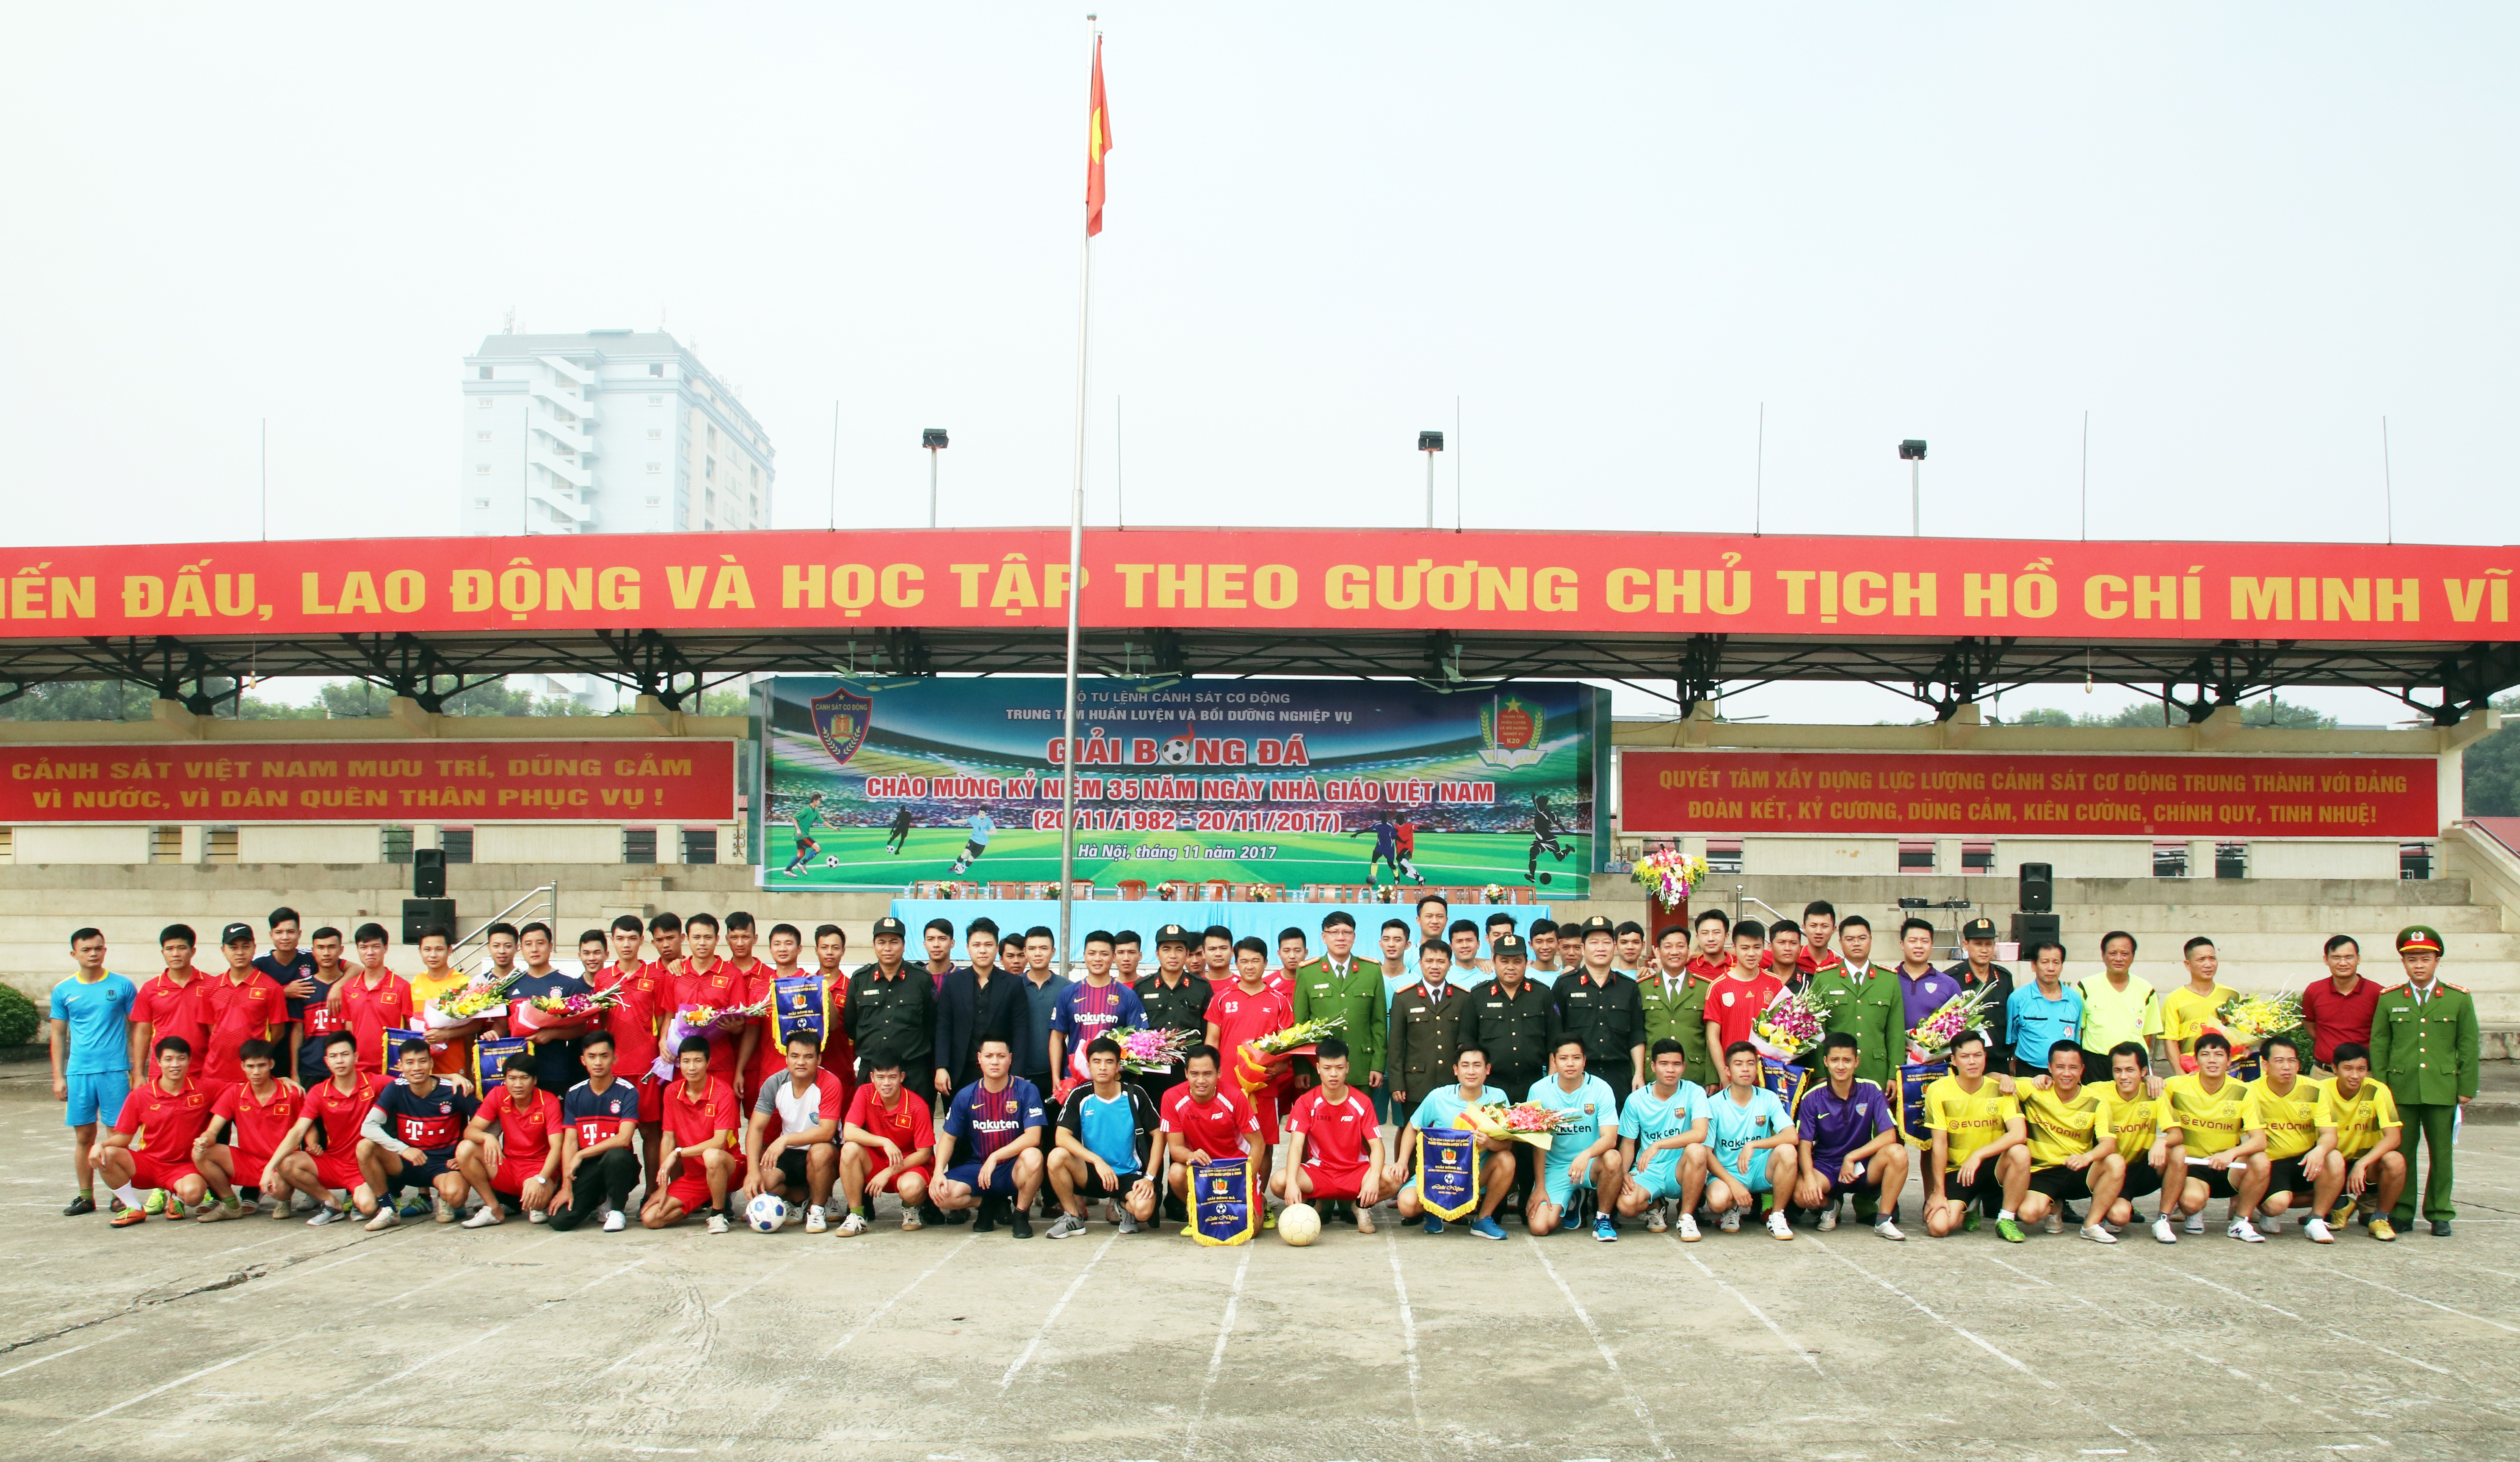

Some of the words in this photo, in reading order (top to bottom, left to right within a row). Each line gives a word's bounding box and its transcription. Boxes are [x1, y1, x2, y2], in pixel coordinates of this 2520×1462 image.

[122, 559, 272, 621] ĐẤU,
[302, 569, 426, 614] LAO
[450, 557, 640, 621] ĐỘNG
[665, 554, 755, 609] VÀ
[782, 563, 924, 617] HỌC
[950, 553, 1089, 616] TẬP
[1115, 564, 1298, 609] THEO
[1325, 559, 1578, 612] GƯƠNG
[1606, 552, 1751, 615] CHỦ
[1777, 571, 1937, 623] TỊCH
[1964, 557, 2057, 618] HỒ
[2084, 565, 2205, 620] CHÍ
[2230, 577, 2419, 621] MINH
[2443, 568, 2513, 622] VĨ
[1091, 692, 1108, 702] TƯ
[1113, 690, 1147, 705] LỆNH
[1152, 690, 1191, 703] CẢNH
[1195, 690, 1222, 703] SÁT
[1226, 692, 1246, 703] CƠ
[1249, 691, 1290, 706] ĐỘNG
[1006, 709, 1051, 720] TRUNG
[1089, 706, 1126, 720] HUẤN
[1131, 708, 1174, 723] LUYỆN
[1179, 708, 1196, 720] VÀ
[1198, 706, 1223, 720] BỒI
[1227, 707, 1275, 721] DƯỠNG
[1279, 709, 1330, 723] NGHIỆP
[1335, 711, 1352, 724] VỤ
[1047, 727, 1122, 764] GIẢI
[1256, 734, 1310, 765] ĐÁ
[12, 758, 98, 779] CẢNH
[111, 759, 171, 778] SÁT
[185, 758, 251, 781] VIỆT
[262, 761, 337, 777] NAM
[348, 759, 422, 777] MƯU
[435, 756, 495, 778] TRÍ,
[508, 754, 601, 776] DŨNG
[614, 753, 691, 776] CẢM
[866, 772, 928, 798] CHÀO
[934, 774, 1002, 799] MỪNG
[1006, 770, 1038, 800] KỶ
[1107, 778, 1139, 800] 35
[1142, 774, 1197, 800] NĂM
[1202, 774, 1266, 801] NGÀY
[1270, 775, 1320, 802] NHÀ
[1324, 775, 1380, 803] GIÁO
[1384, 777, 1435, 807] VIỆT
[1440, 781, 1495, 803] NAM
[1660, 765, 1721, 789] QUYẾT
[1729, 767, 1769, 788] TÂM
[1775, 767, 1813, 789] XÂY
[1819, 770, 1872, 792] DỰNG
[1879, 770, 1915, 793] LỰC
[1921, 771, 1985, 793] LƯỢNG
[1992, 766, 2044, 790] CẢNH
[2051, 769, 2087, 790] SÁT
[2093, 773, 2119, 791] CƠ
[2125, 771, 2177, 794] ĐỘNG
[2184, 775, 2245, 792] TRUNG
[2252, 772, 2314, 792] THÀNH
[2321, 771, 2351, 792] VỚI
[2355, 770, 2407, 793] ĐẢNG
[33, 789, 61, 808] VÌ
[73, 786, 170, 809] NƯỚC,
[180, 788, 209, 807] VÌ
[221, 787, 288, 807] DÂN
[300, 786, 388, 808] QUÊN
[398, 786, 486, 806] THÂN
[498, 789, 589, 810] PHỤC
[600, 789, 644, 810] VỤ
[655, 789, 663, 806] !
[1033, 808, 1177, 832] (20/11/1982
[1180, 818, 1192, 826] -
[1196, 810, 1342, 835] 20/11/2017)
[1688, 797, 1743, 818] ĐOÀN
[1751, 796, 1792, 821] KẾT,
[1799, 796, 1823, 819] KỶ
[1830, 800, 1902, 821] CƯƠNG,
[1908, 798, 1961, 820] DŨNG
[1968, 797, 2017, 822] CẢM,
[2024, 800, 2069, 821] KIÊN
[2075, 798, 2147, 823] CƯỜNG,
[2153, 801, 2213, 822] CHÍNH
[2219, 805, 2262, 824] QUY,
[2269, 805, 2312, 822] TINH
[2319, 803, 2376, 826] NHUỆ!
[1078, 844, 1098, 858] Hà
[1101, 844, 1131, 861] Nội,
[1135, 844, 1178, 861] tháng
[1183, 845, 1199, 858] 11
[1204, 845, 1236, 859] năm
[1239, 846, 1278, 859] 2017
[1225, 1001, 1238, 1013] 23
[1074, 1012, 1119, 1024] Rakuten
[973, 1119, 1019, 1130] Rakuten
[1961, 1119, 1998, 1128] EVONIK
[2192, 1119, 2233, 1130] EVONIK
